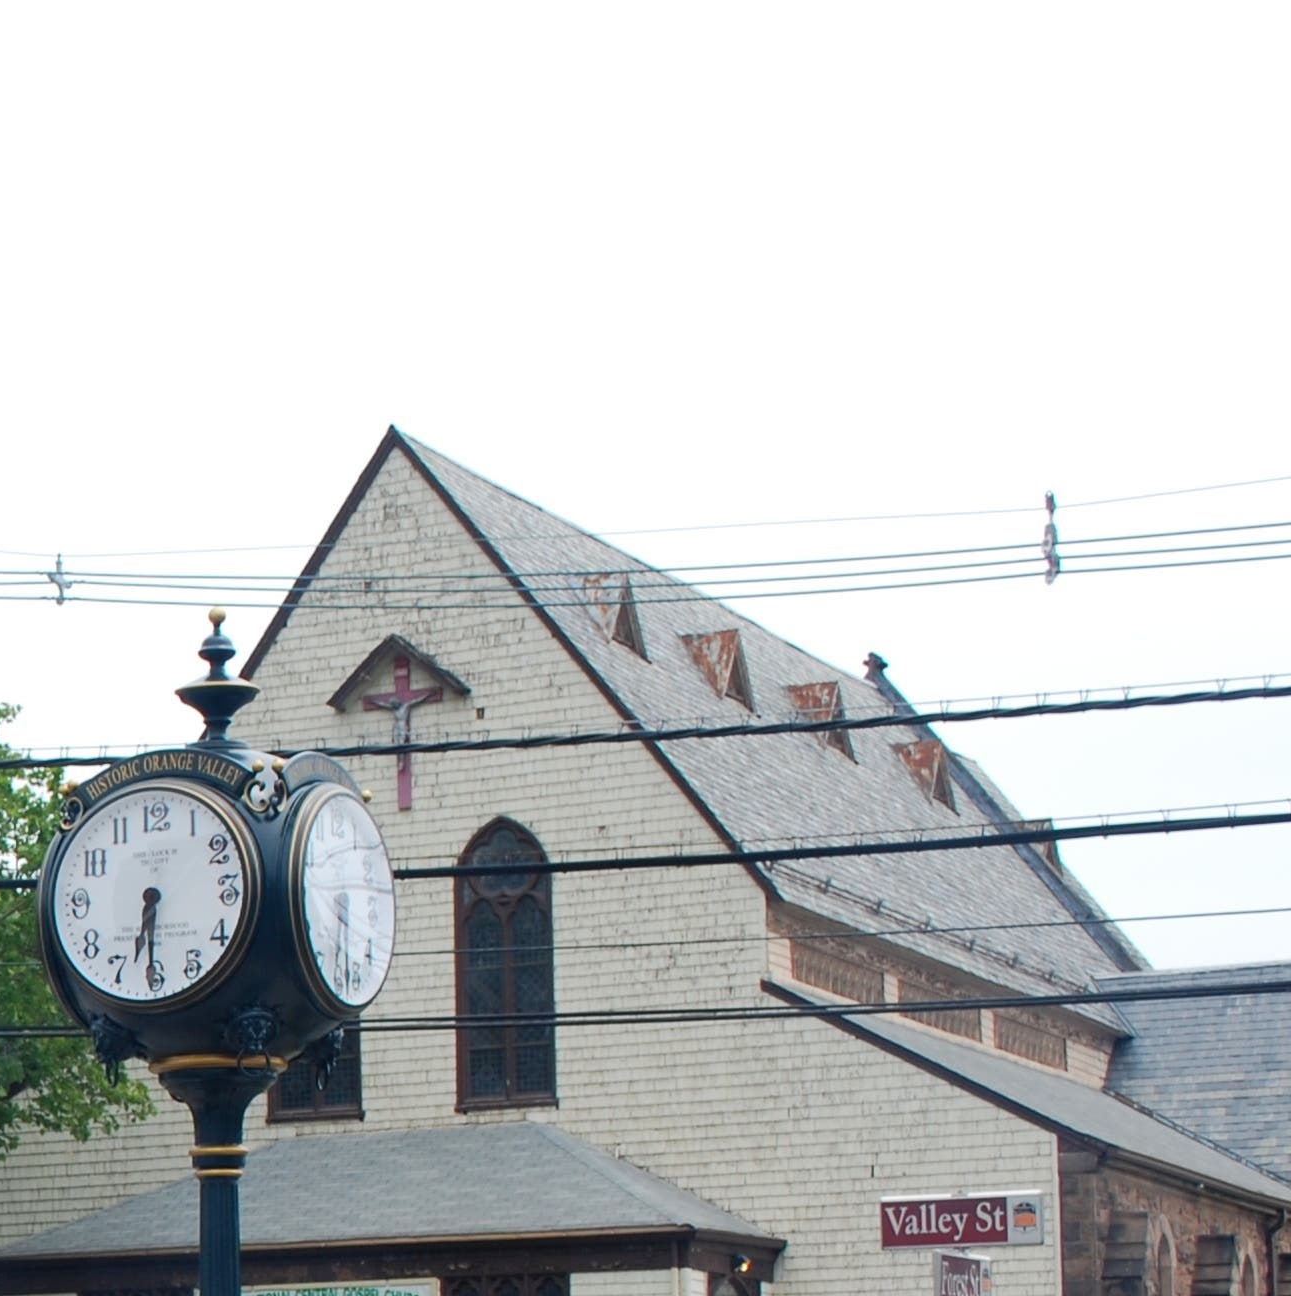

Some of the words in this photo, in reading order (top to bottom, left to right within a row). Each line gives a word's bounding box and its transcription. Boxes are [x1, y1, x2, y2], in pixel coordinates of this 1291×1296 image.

[85, 760, 140, 800] HISTORIC
[143, 752, 194, 773] ORANGE
[197, 755, 243, 786] VALLEY
[143, 801, 171, 833] 12
[83, 848, 106, 878] 10
[208, 834, 230, 865] 2
[71, 888, 91, 920] 9
[217, 873, 241, 907] 3
[83, 928, 100, 959] 8
[209, 918, 230, 947] 4
[107, 954, 128, 985] 7
[184, 949, 202, 980] 5
[884, 1203, 969, 1241] Valley
[975, 1201, 1005, 1233] St
